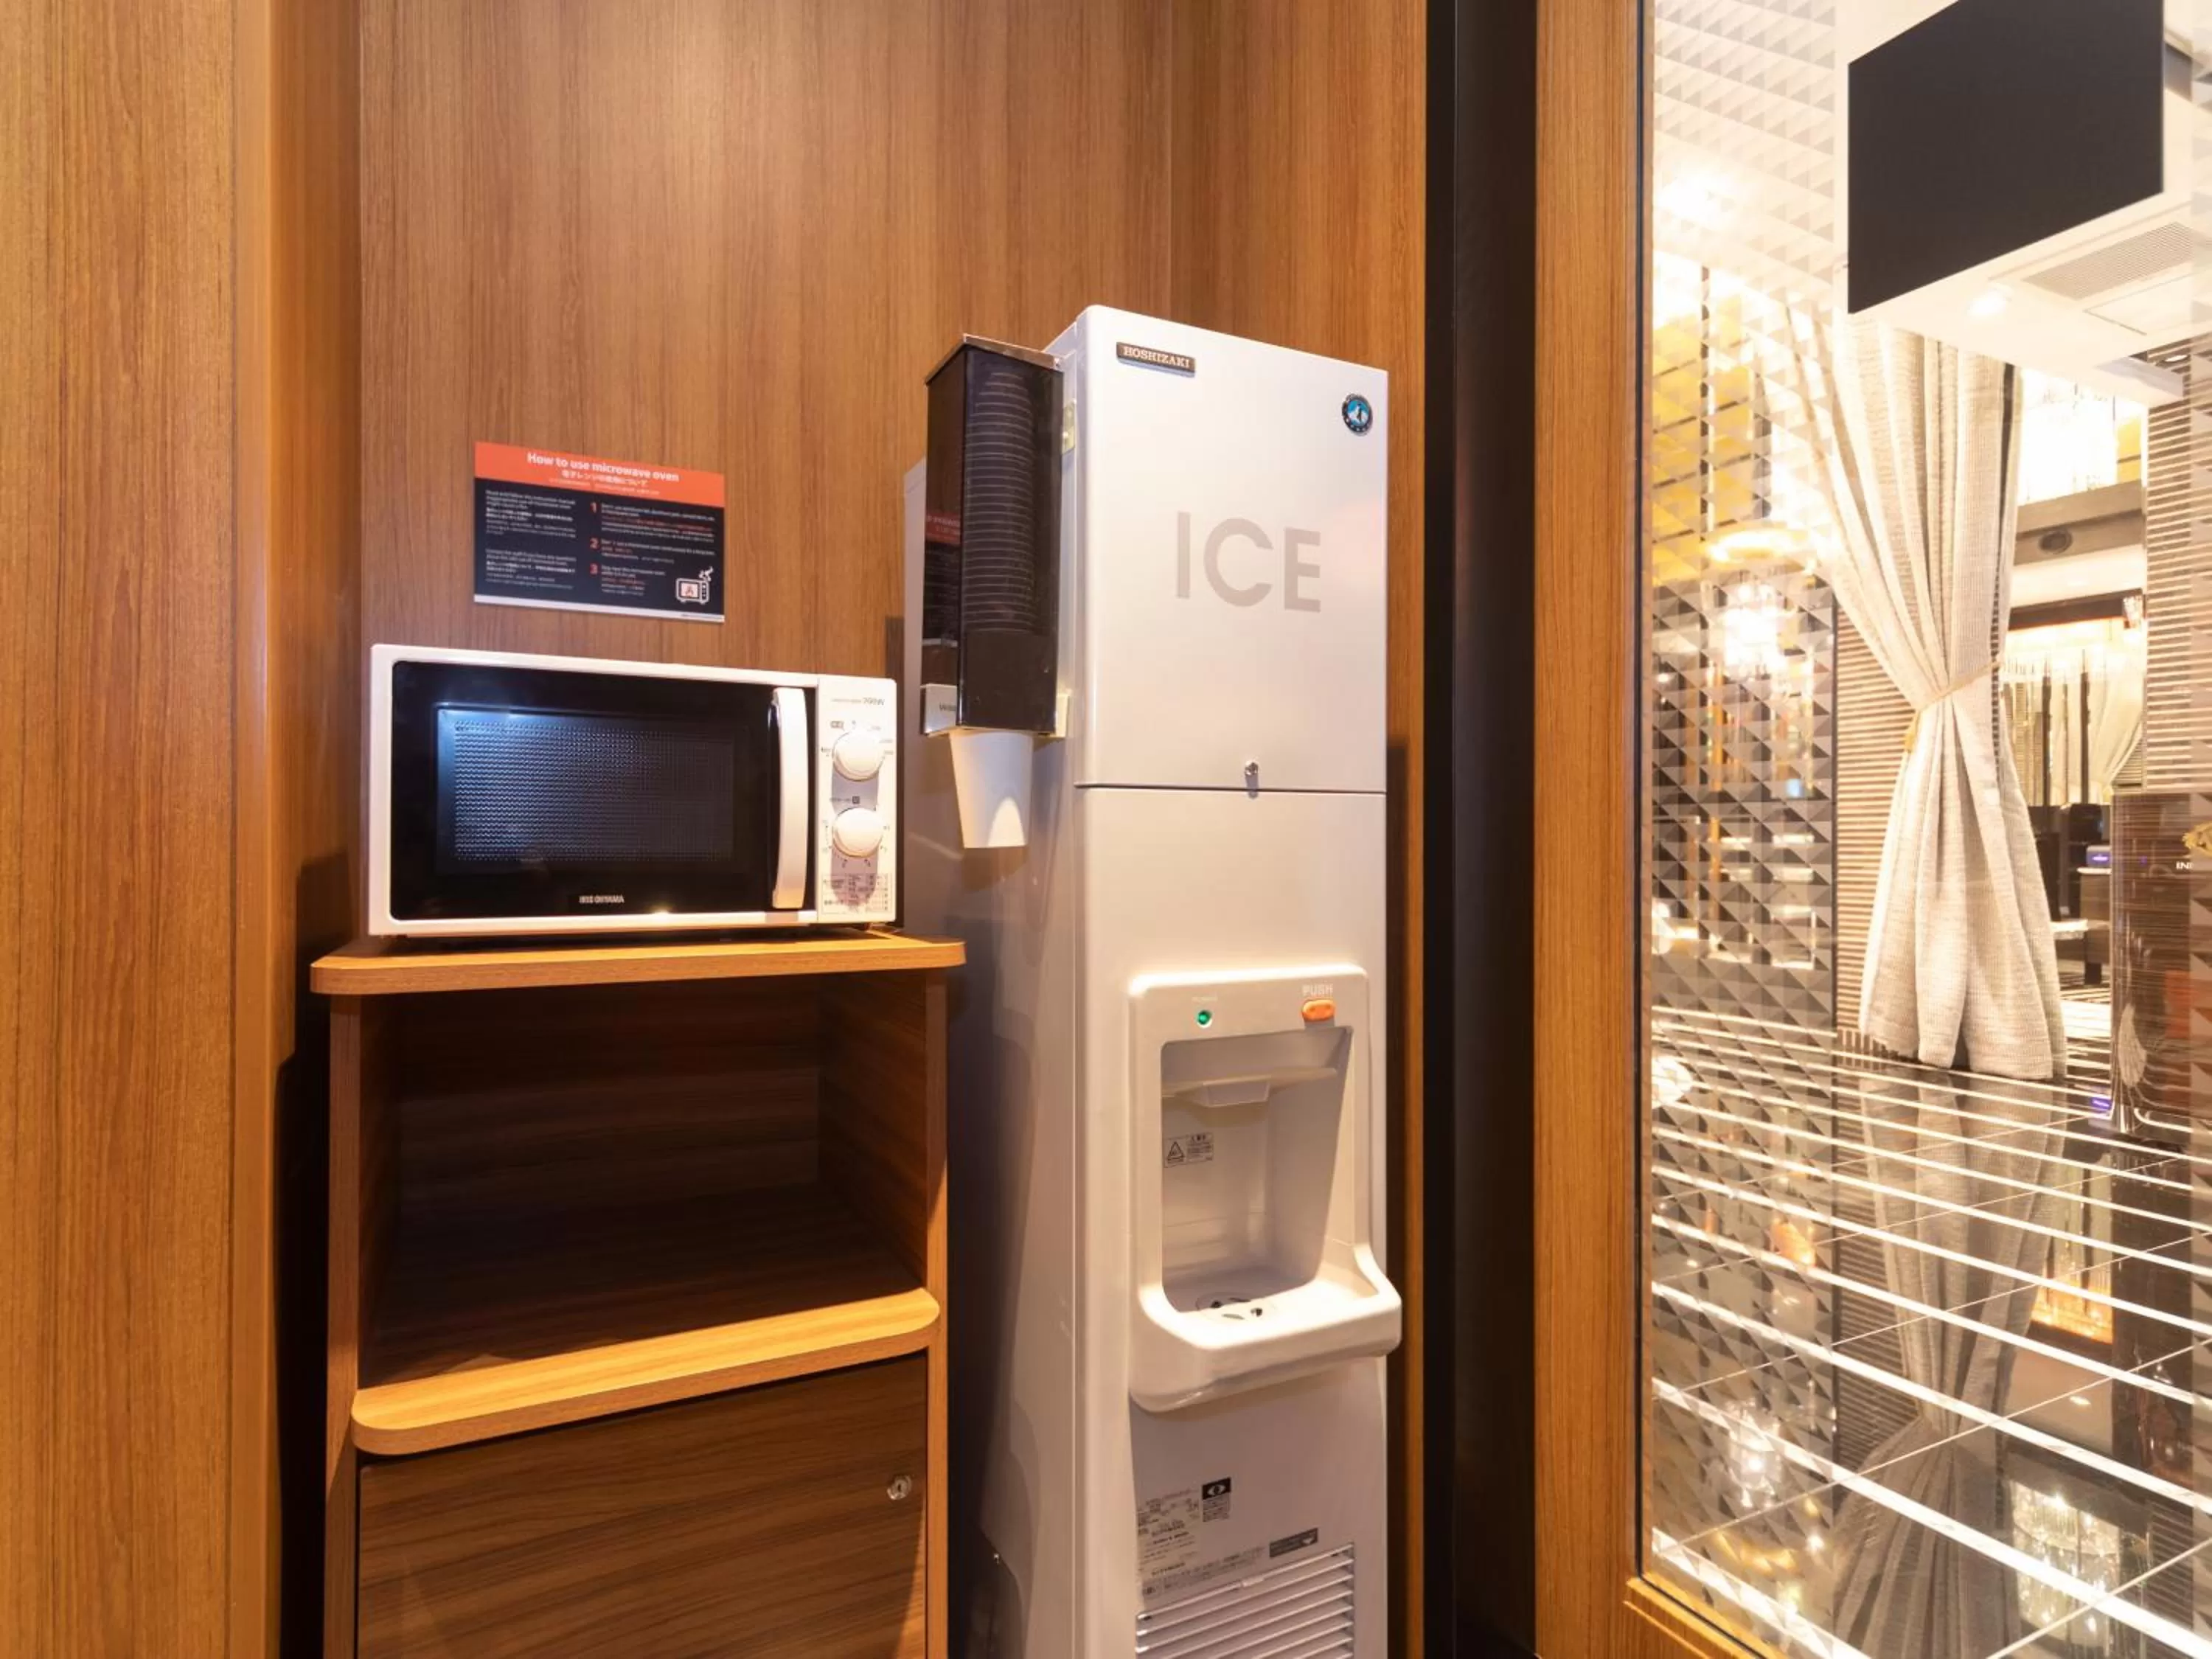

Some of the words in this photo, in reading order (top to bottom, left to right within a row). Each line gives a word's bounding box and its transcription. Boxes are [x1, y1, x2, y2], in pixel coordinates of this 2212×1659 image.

[1123, 345, 1190, 368] HOSHIZAKI
[526, 451, 554, 465] How
[555, 457, 568, 467] to
[570, 459, 590, 470] use
[592, 462, 651, 479] microwave
[653, 471, 680, 482] oven
[590, 501, 597, 514] 1
[590, 538, 599, 550] 2
[590, 563, 599, 575] 3
[1176, 511, 1321, 613] ICE
